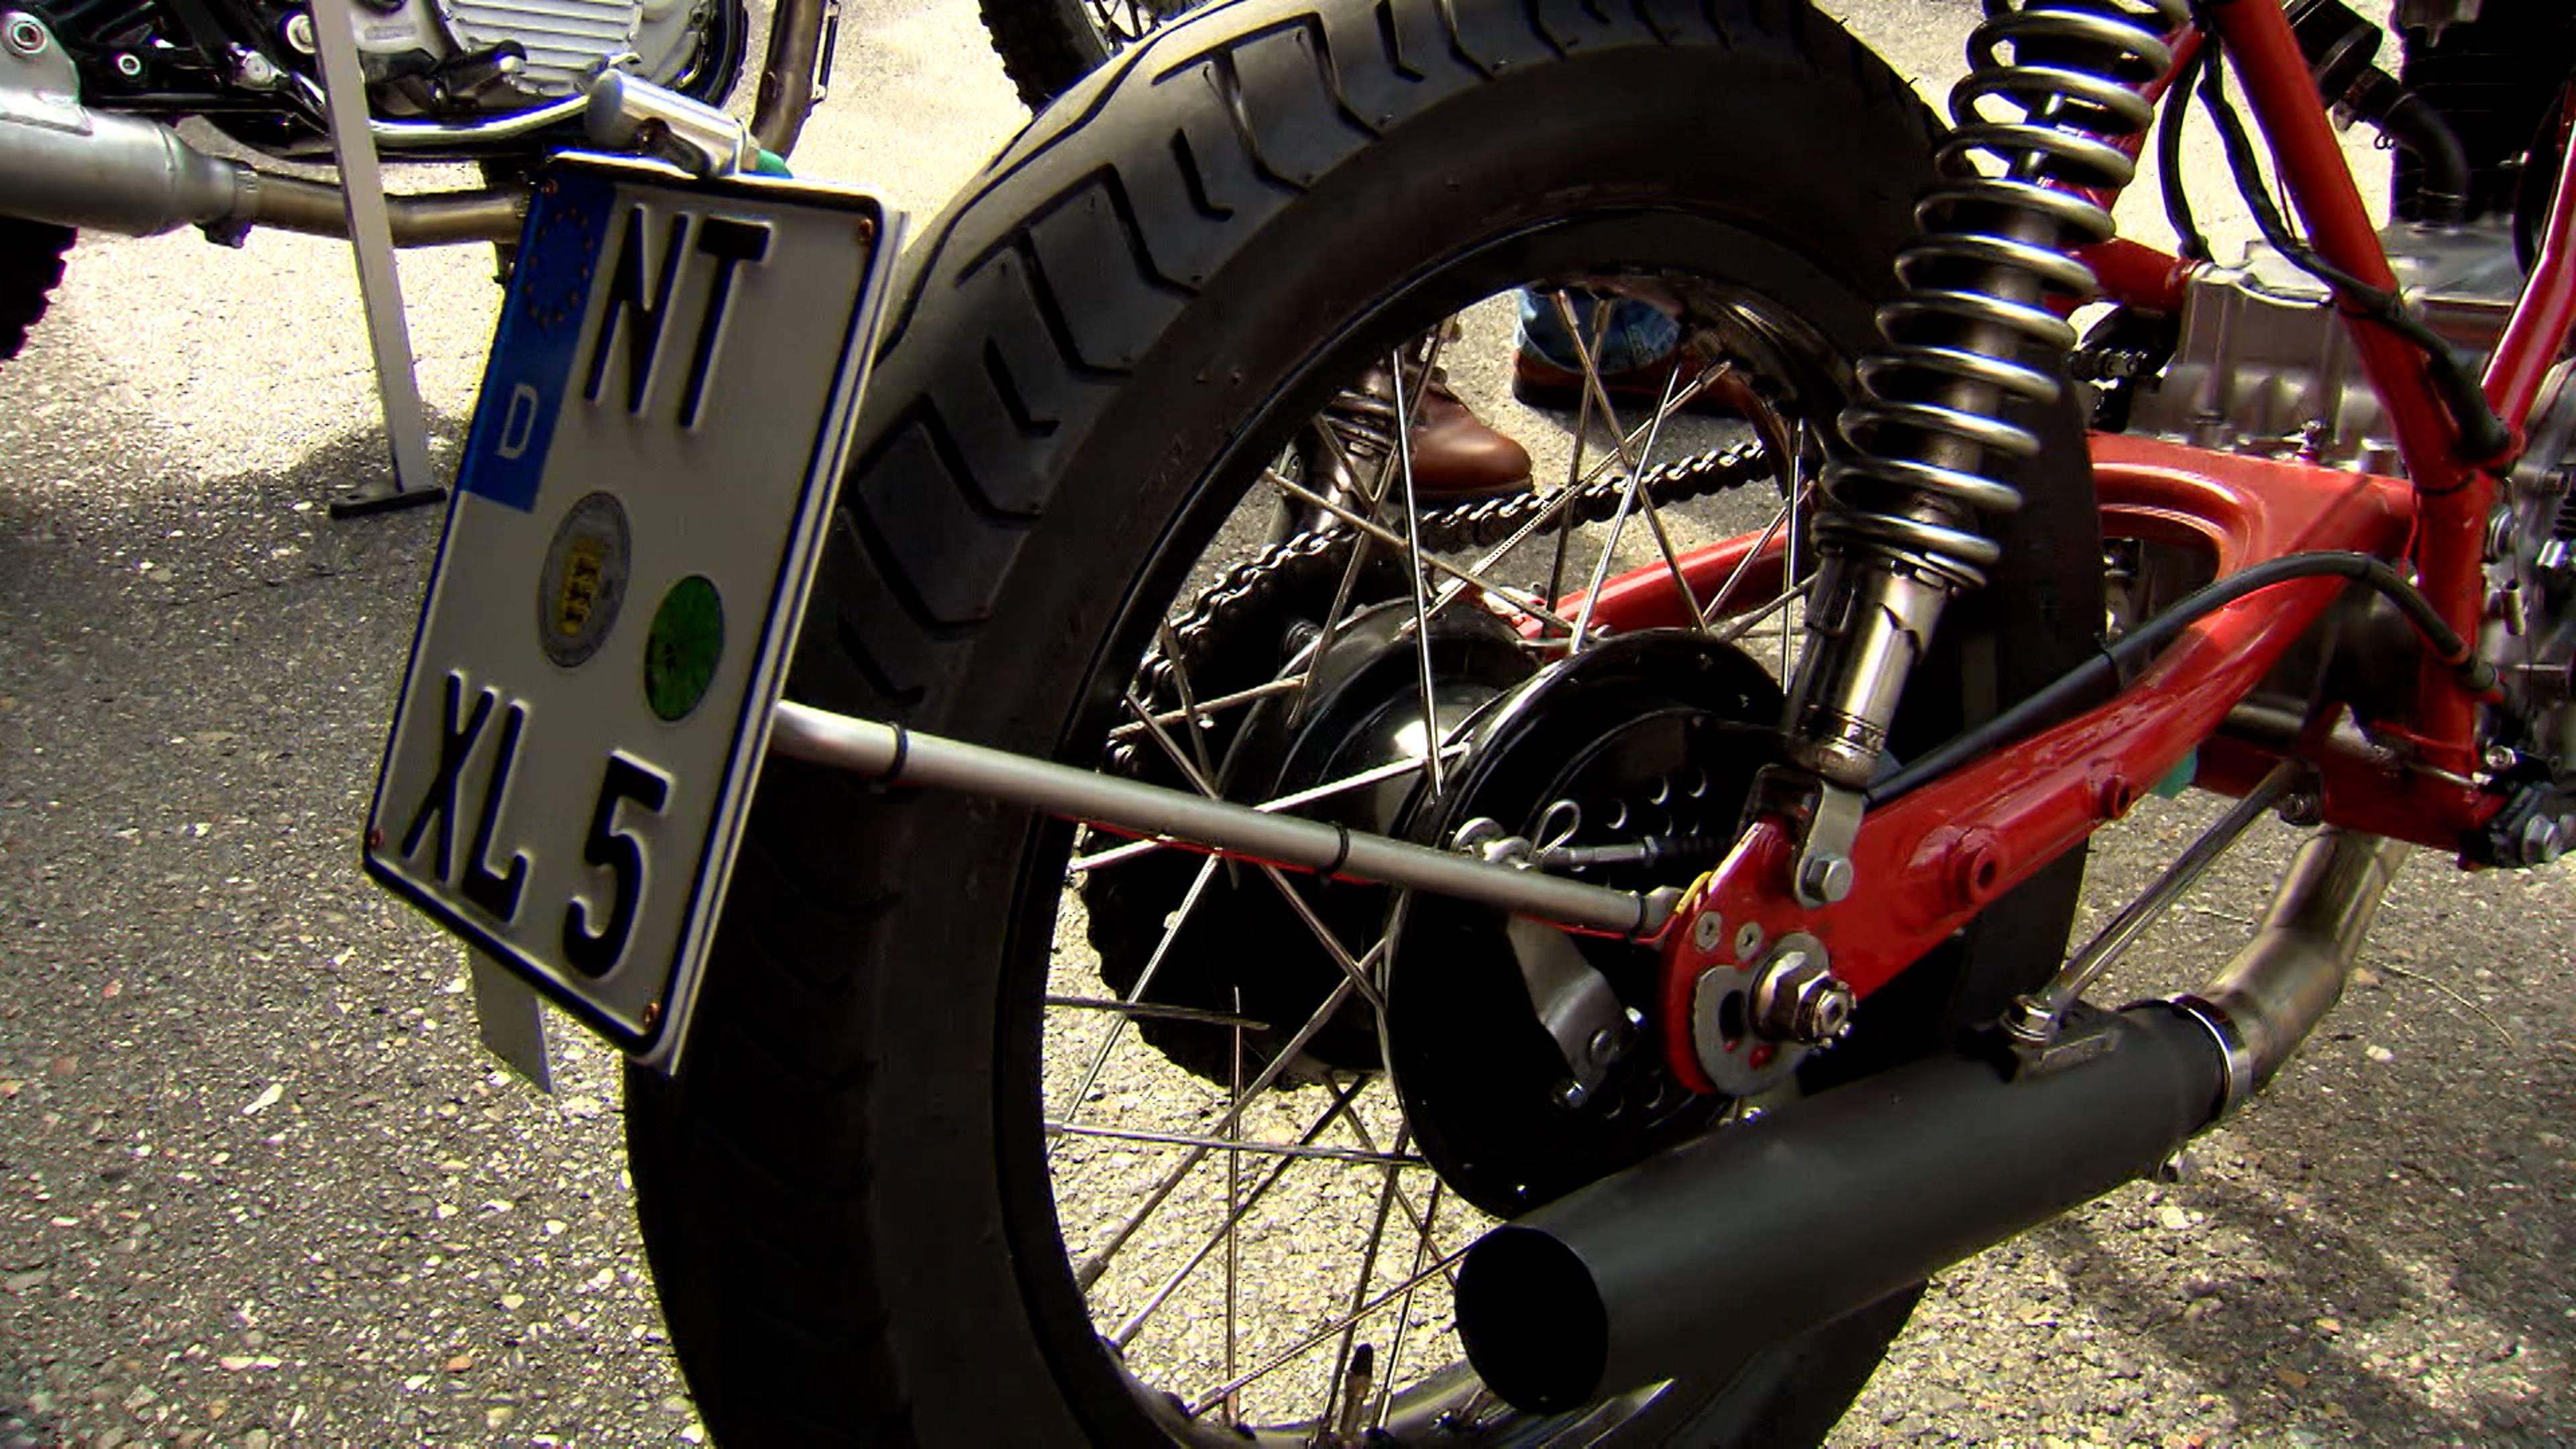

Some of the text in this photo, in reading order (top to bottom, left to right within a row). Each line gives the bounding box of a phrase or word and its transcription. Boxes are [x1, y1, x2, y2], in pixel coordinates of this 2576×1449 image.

[496, 384, 537, 460] D
[584, 203, 773, 431] NT
[403, 669, 672, 979] XL 5
